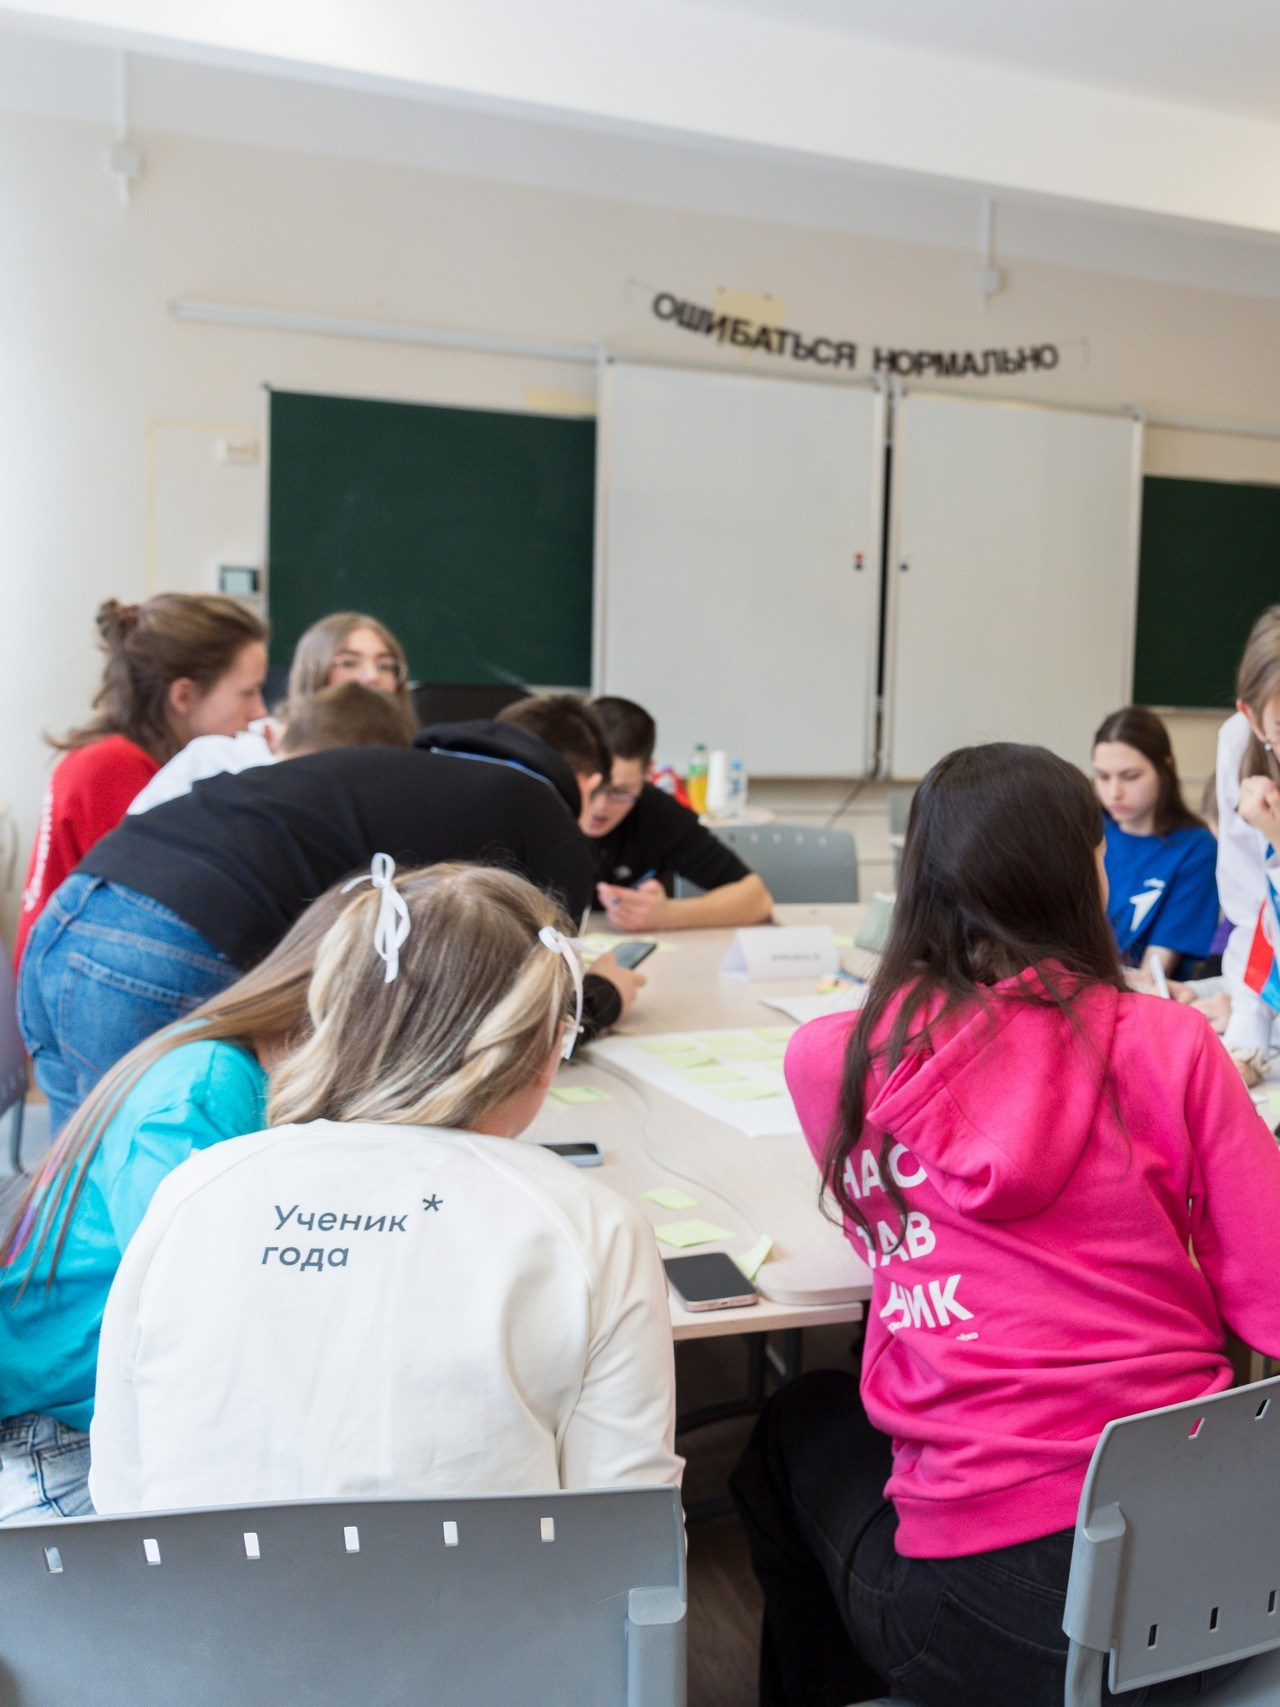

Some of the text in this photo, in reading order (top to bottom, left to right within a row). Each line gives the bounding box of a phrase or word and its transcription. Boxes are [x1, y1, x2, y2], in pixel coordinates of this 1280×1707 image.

[652, 292, 1059, 378] ОШИБАТЬСЯ НОРМАЛЬНО
[274, 1204, 409, 1233] Ученик
[261, 1246, 350, 1272] года
